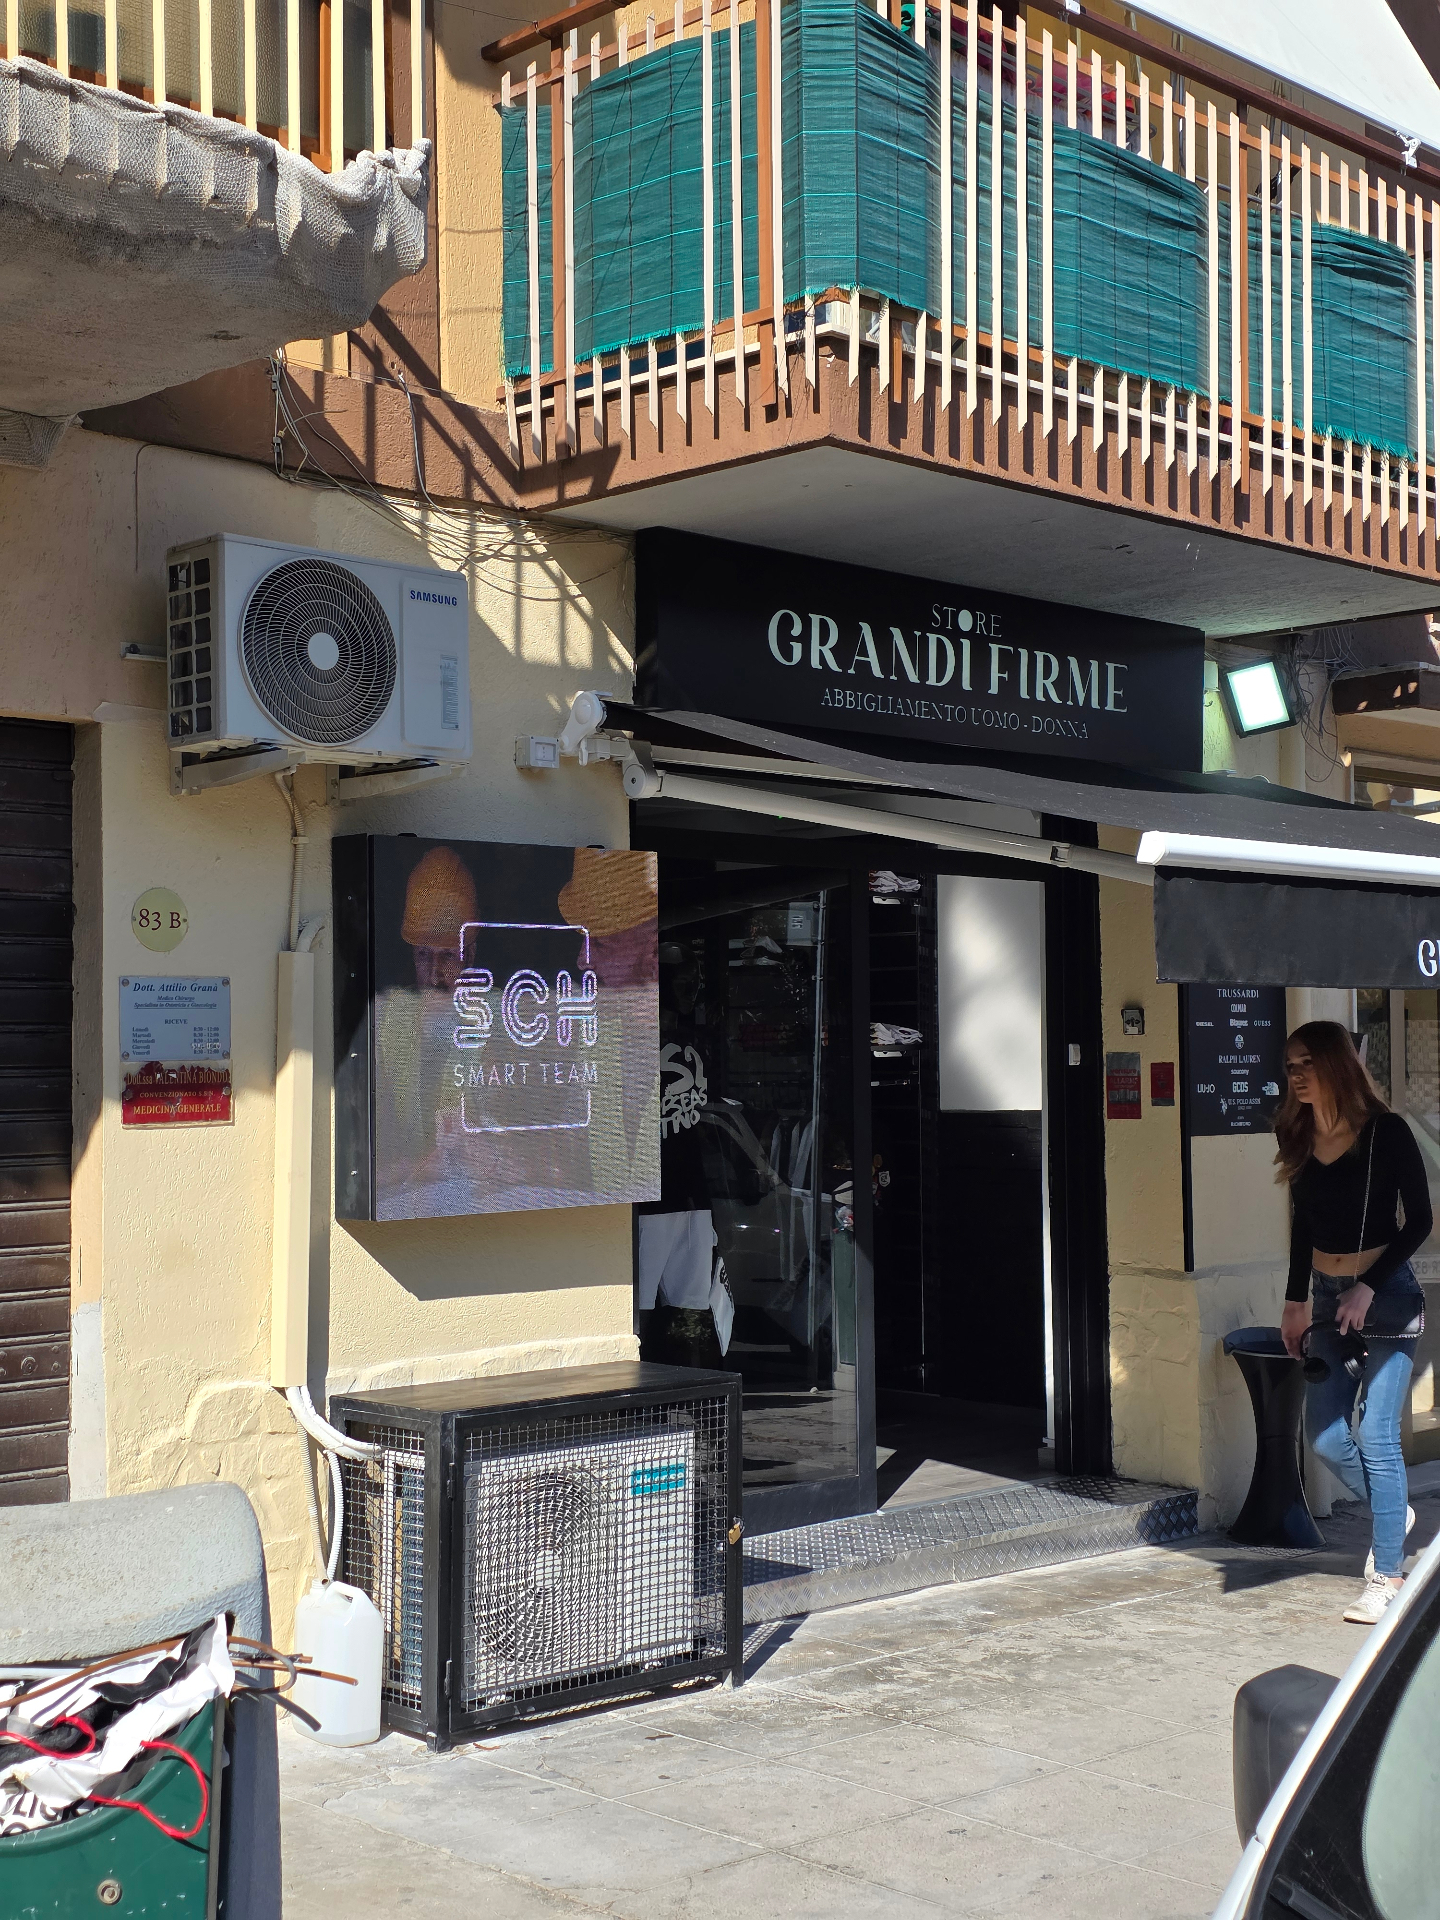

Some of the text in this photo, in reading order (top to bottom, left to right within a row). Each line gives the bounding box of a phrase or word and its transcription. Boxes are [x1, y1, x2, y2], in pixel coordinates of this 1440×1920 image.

[410, 589, 458, 607] SAMSUNG
[931, 603, 1003, 638] STORE
[767, 608, 1129, 713] GRANDI FIRME
[820, 687, 967, 724] ABBIGLIAMENTO
[970, 707, 1020, 730] UOMO
[1031, 715, 1089, 740] DONNA
[138, 908, 182, 931] 83 B
[1418, 939, 1440, 977] G
[133, 982, 218, 992] Dott. Attilio Granà
[1217, 988, 1259, 998] TRUSSARDI
[452, 967, 599, 1049] SCH
[1218, 1054, 1261, 1064] RALPH LAUREN
[453, 1061, 599, 1087] SMART TEAM
[1232, 1081, 1249, 1093] GCDS
[133, 1103, 222, 1115] MEDICINA GENERALE
